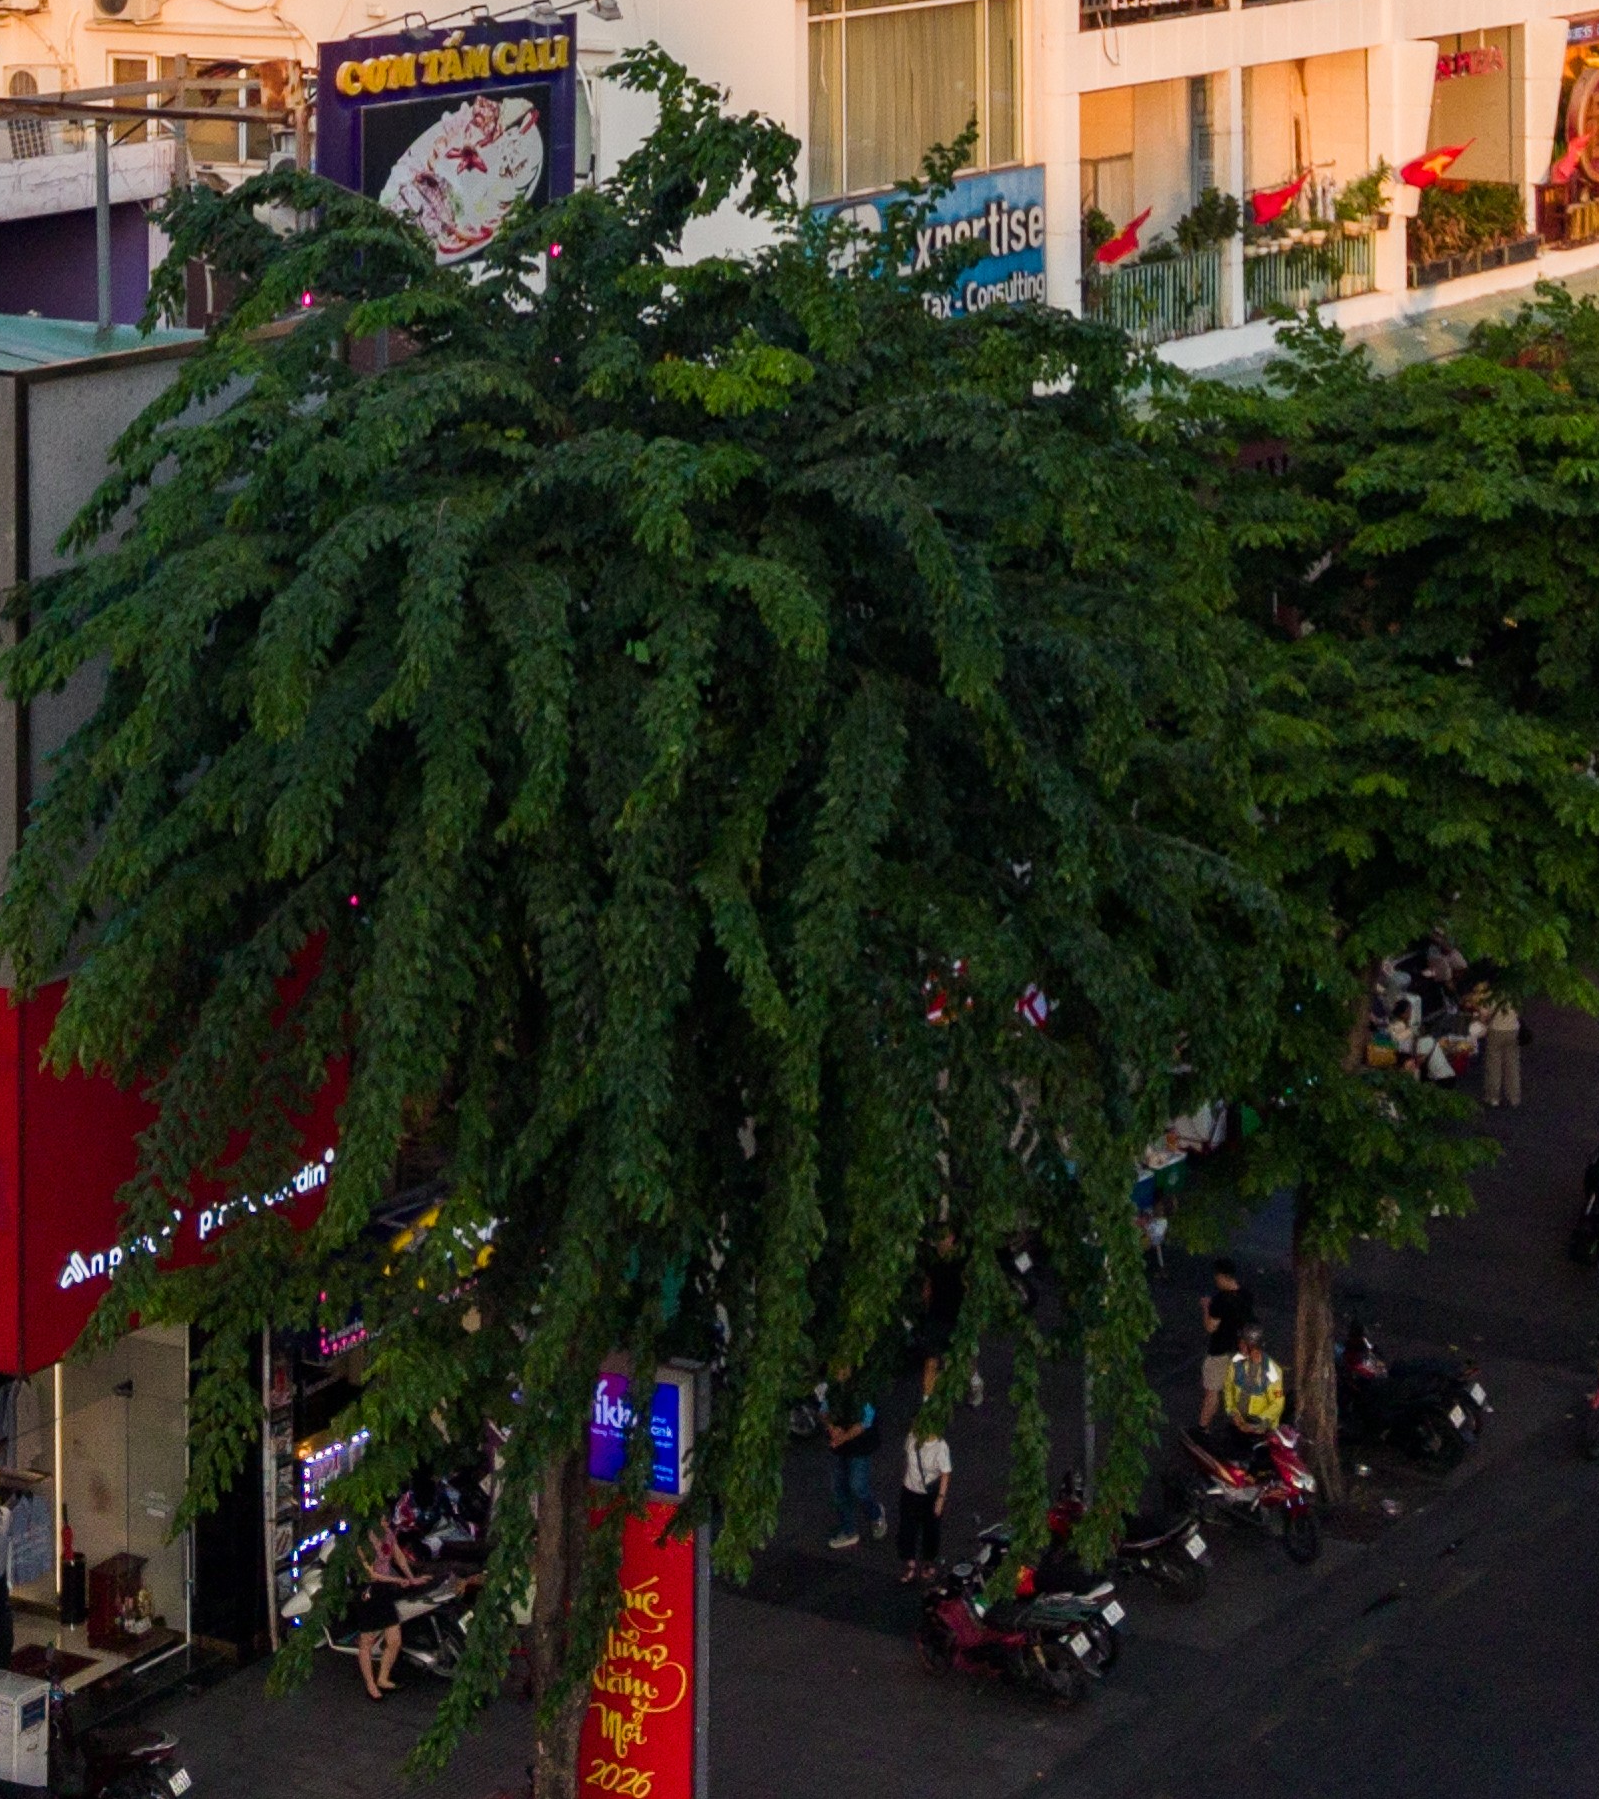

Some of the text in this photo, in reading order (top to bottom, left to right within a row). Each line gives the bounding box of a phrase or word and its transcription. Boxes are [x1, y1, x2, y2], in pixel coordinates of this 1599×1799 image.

[492, 34, 571, 76] CALI
[965, 270, 1046, 315] Consulting
[585, 1759, 656, 1799] 2026
